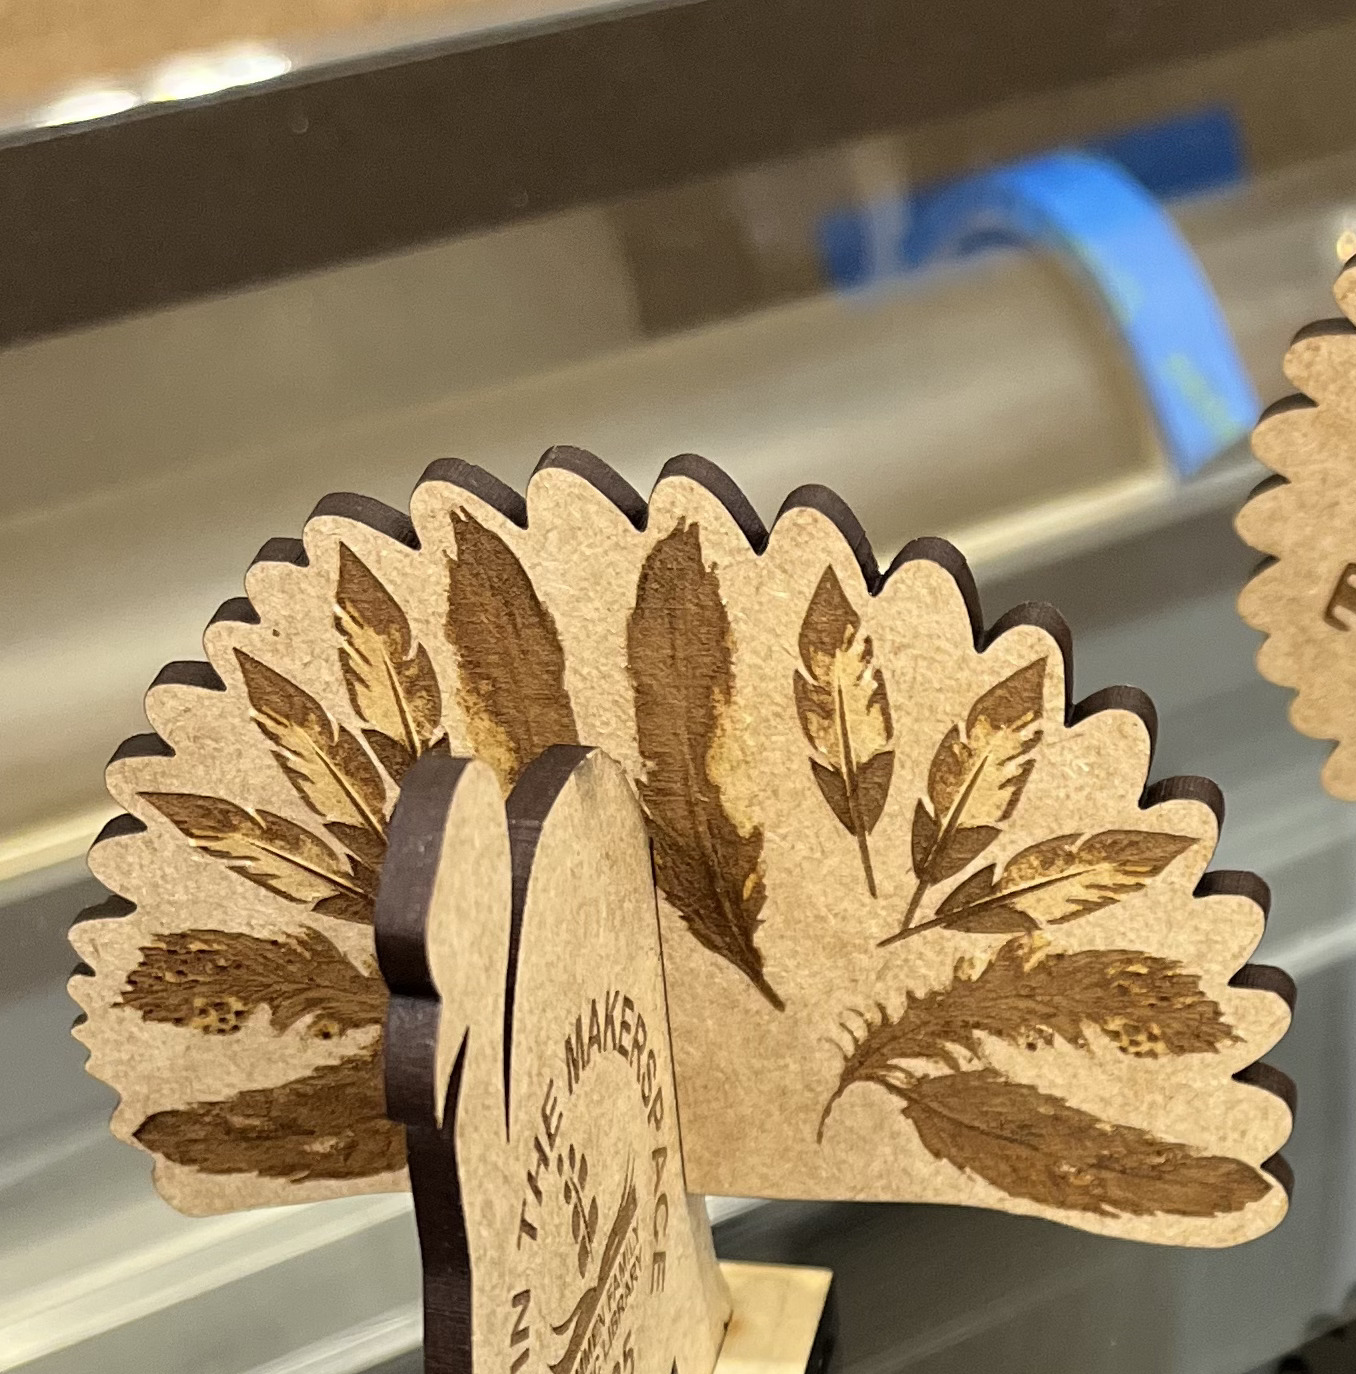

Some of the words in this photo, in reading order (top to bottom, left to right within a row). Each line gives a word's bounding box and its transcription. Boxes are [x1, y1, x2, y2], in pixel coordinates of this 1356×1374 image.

[517, 1078, 564, 1251] THE
[564, 989, 669, 1294] MAKERSPACE
[601, 1244, 643, 1363] LIBRARY
